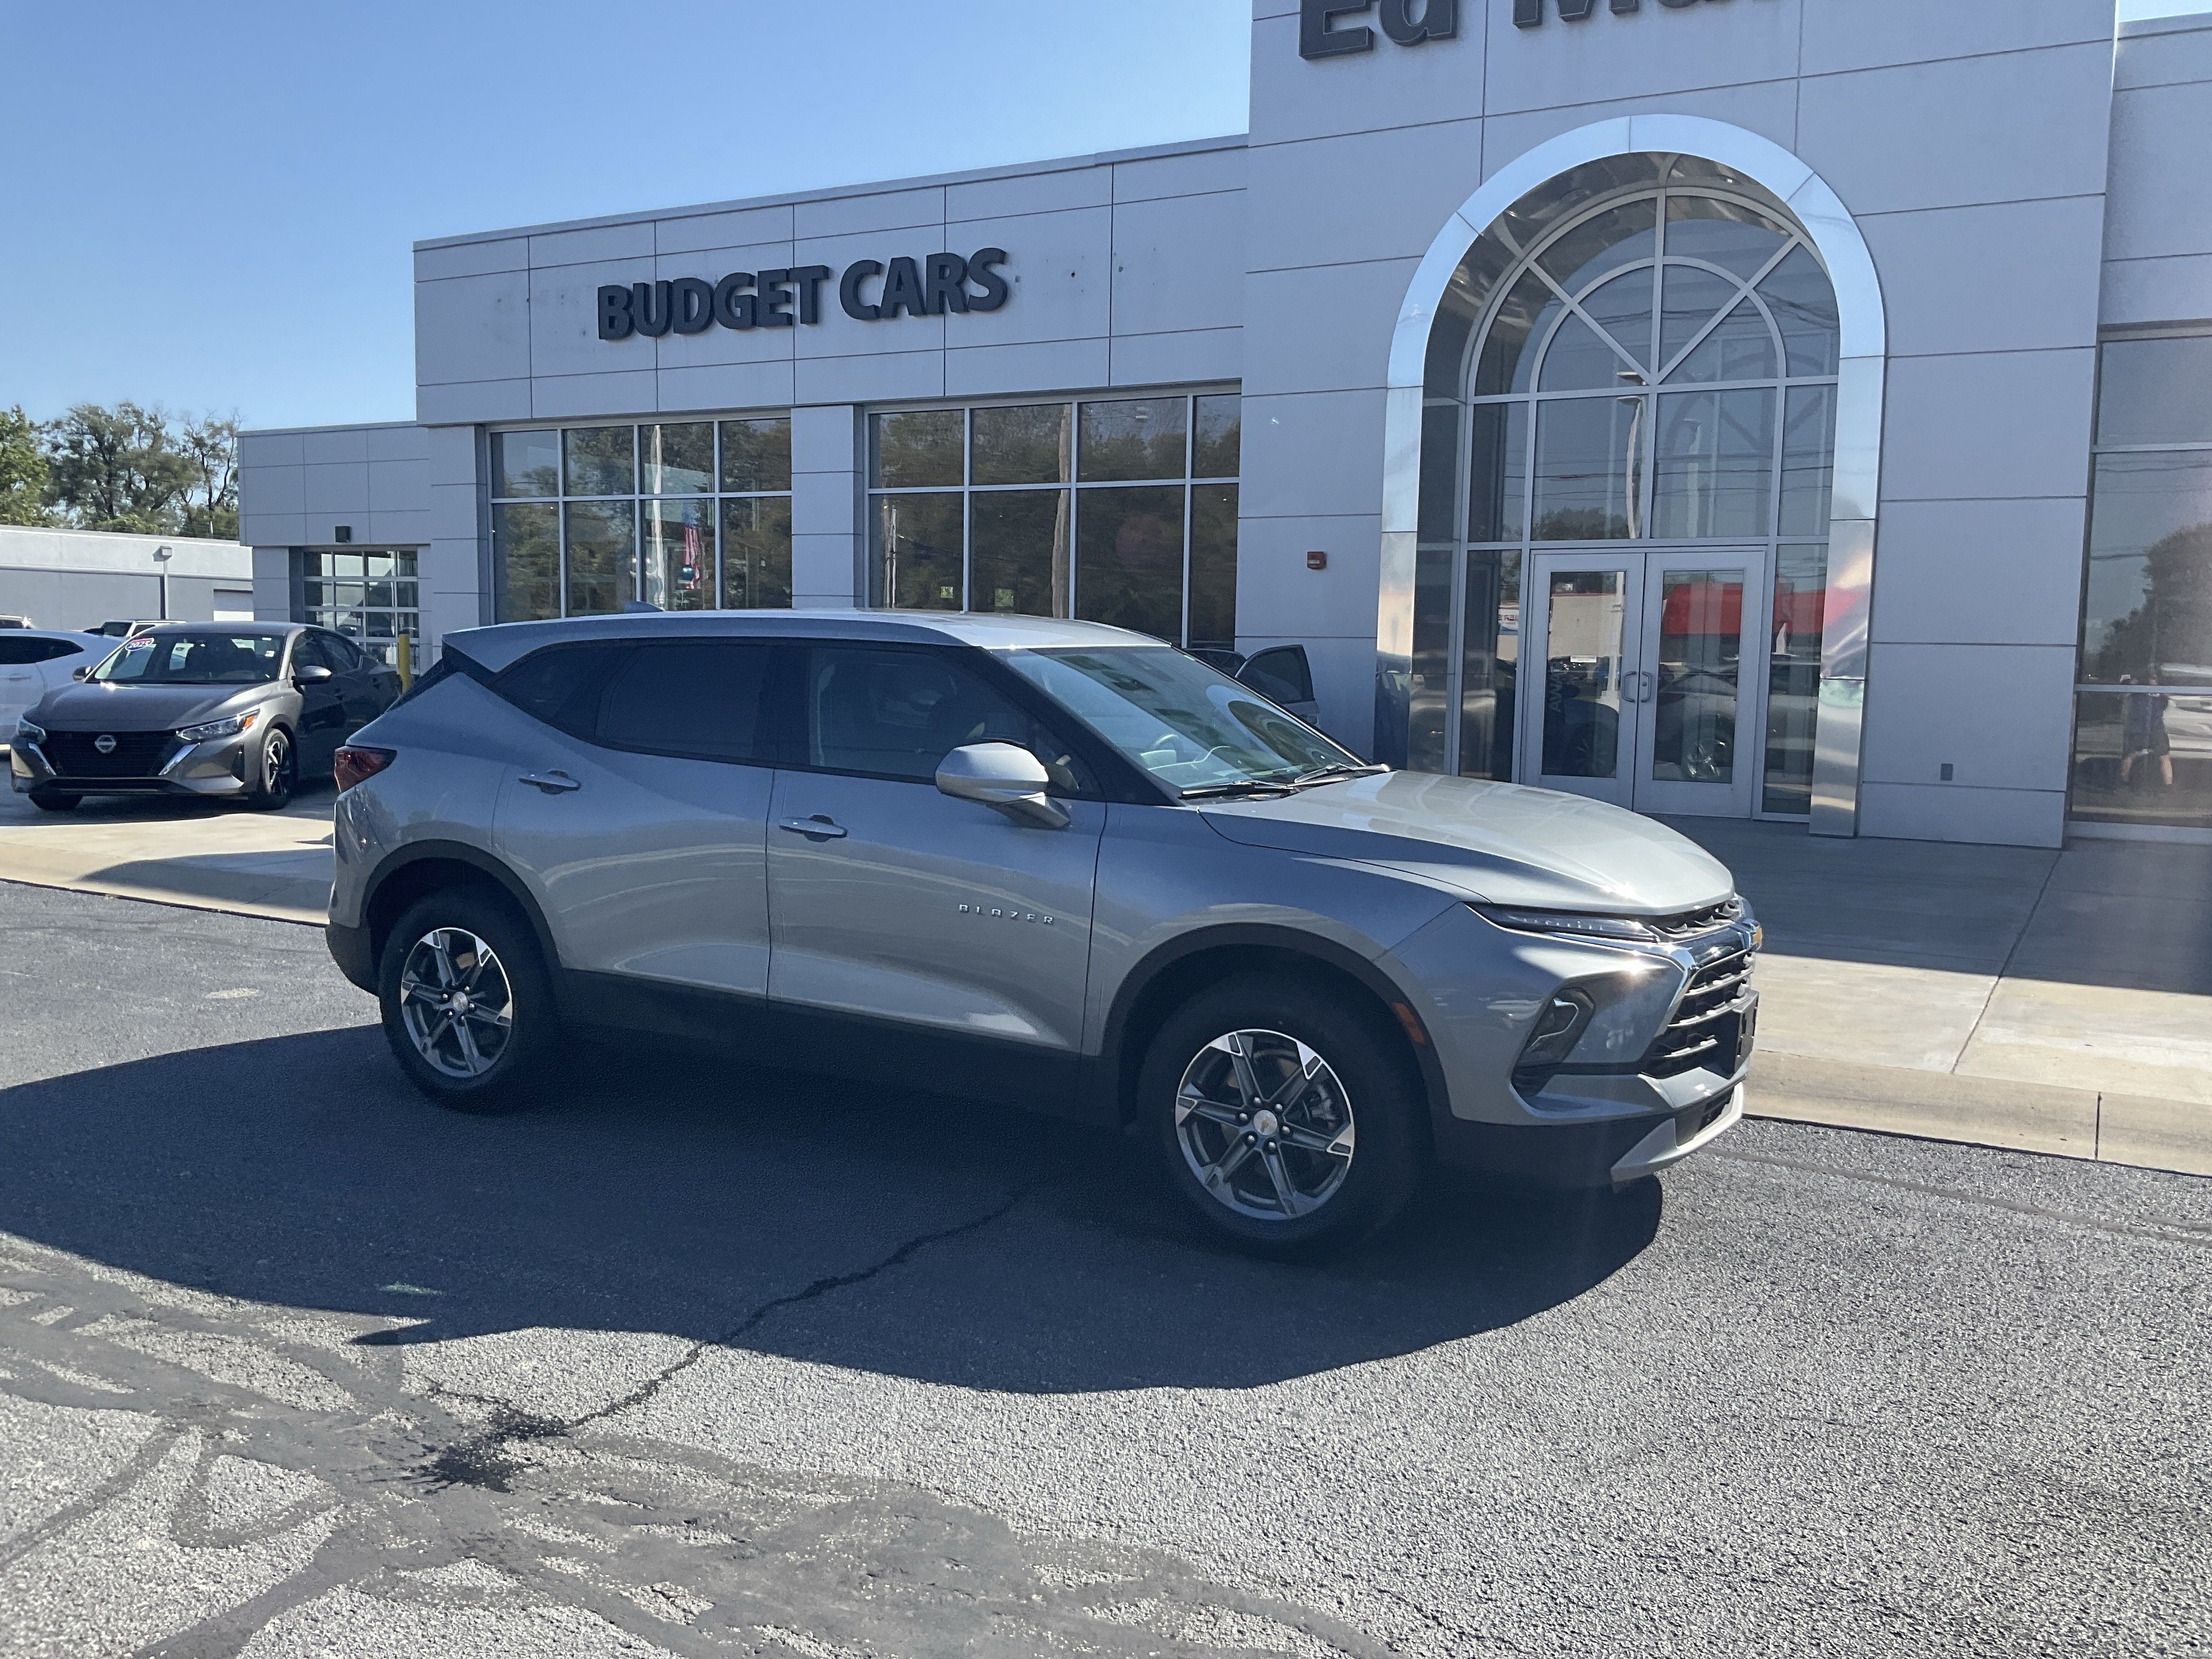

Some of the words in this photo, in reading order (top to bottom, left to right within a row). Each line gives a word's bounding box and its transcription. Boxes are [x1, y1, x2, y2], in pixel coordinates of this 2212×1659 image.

[597, 265, 829, 340] BUDGET
[840, 247, 1008, 320] CARS
[958, 904, 1054, 925] BLAZER
